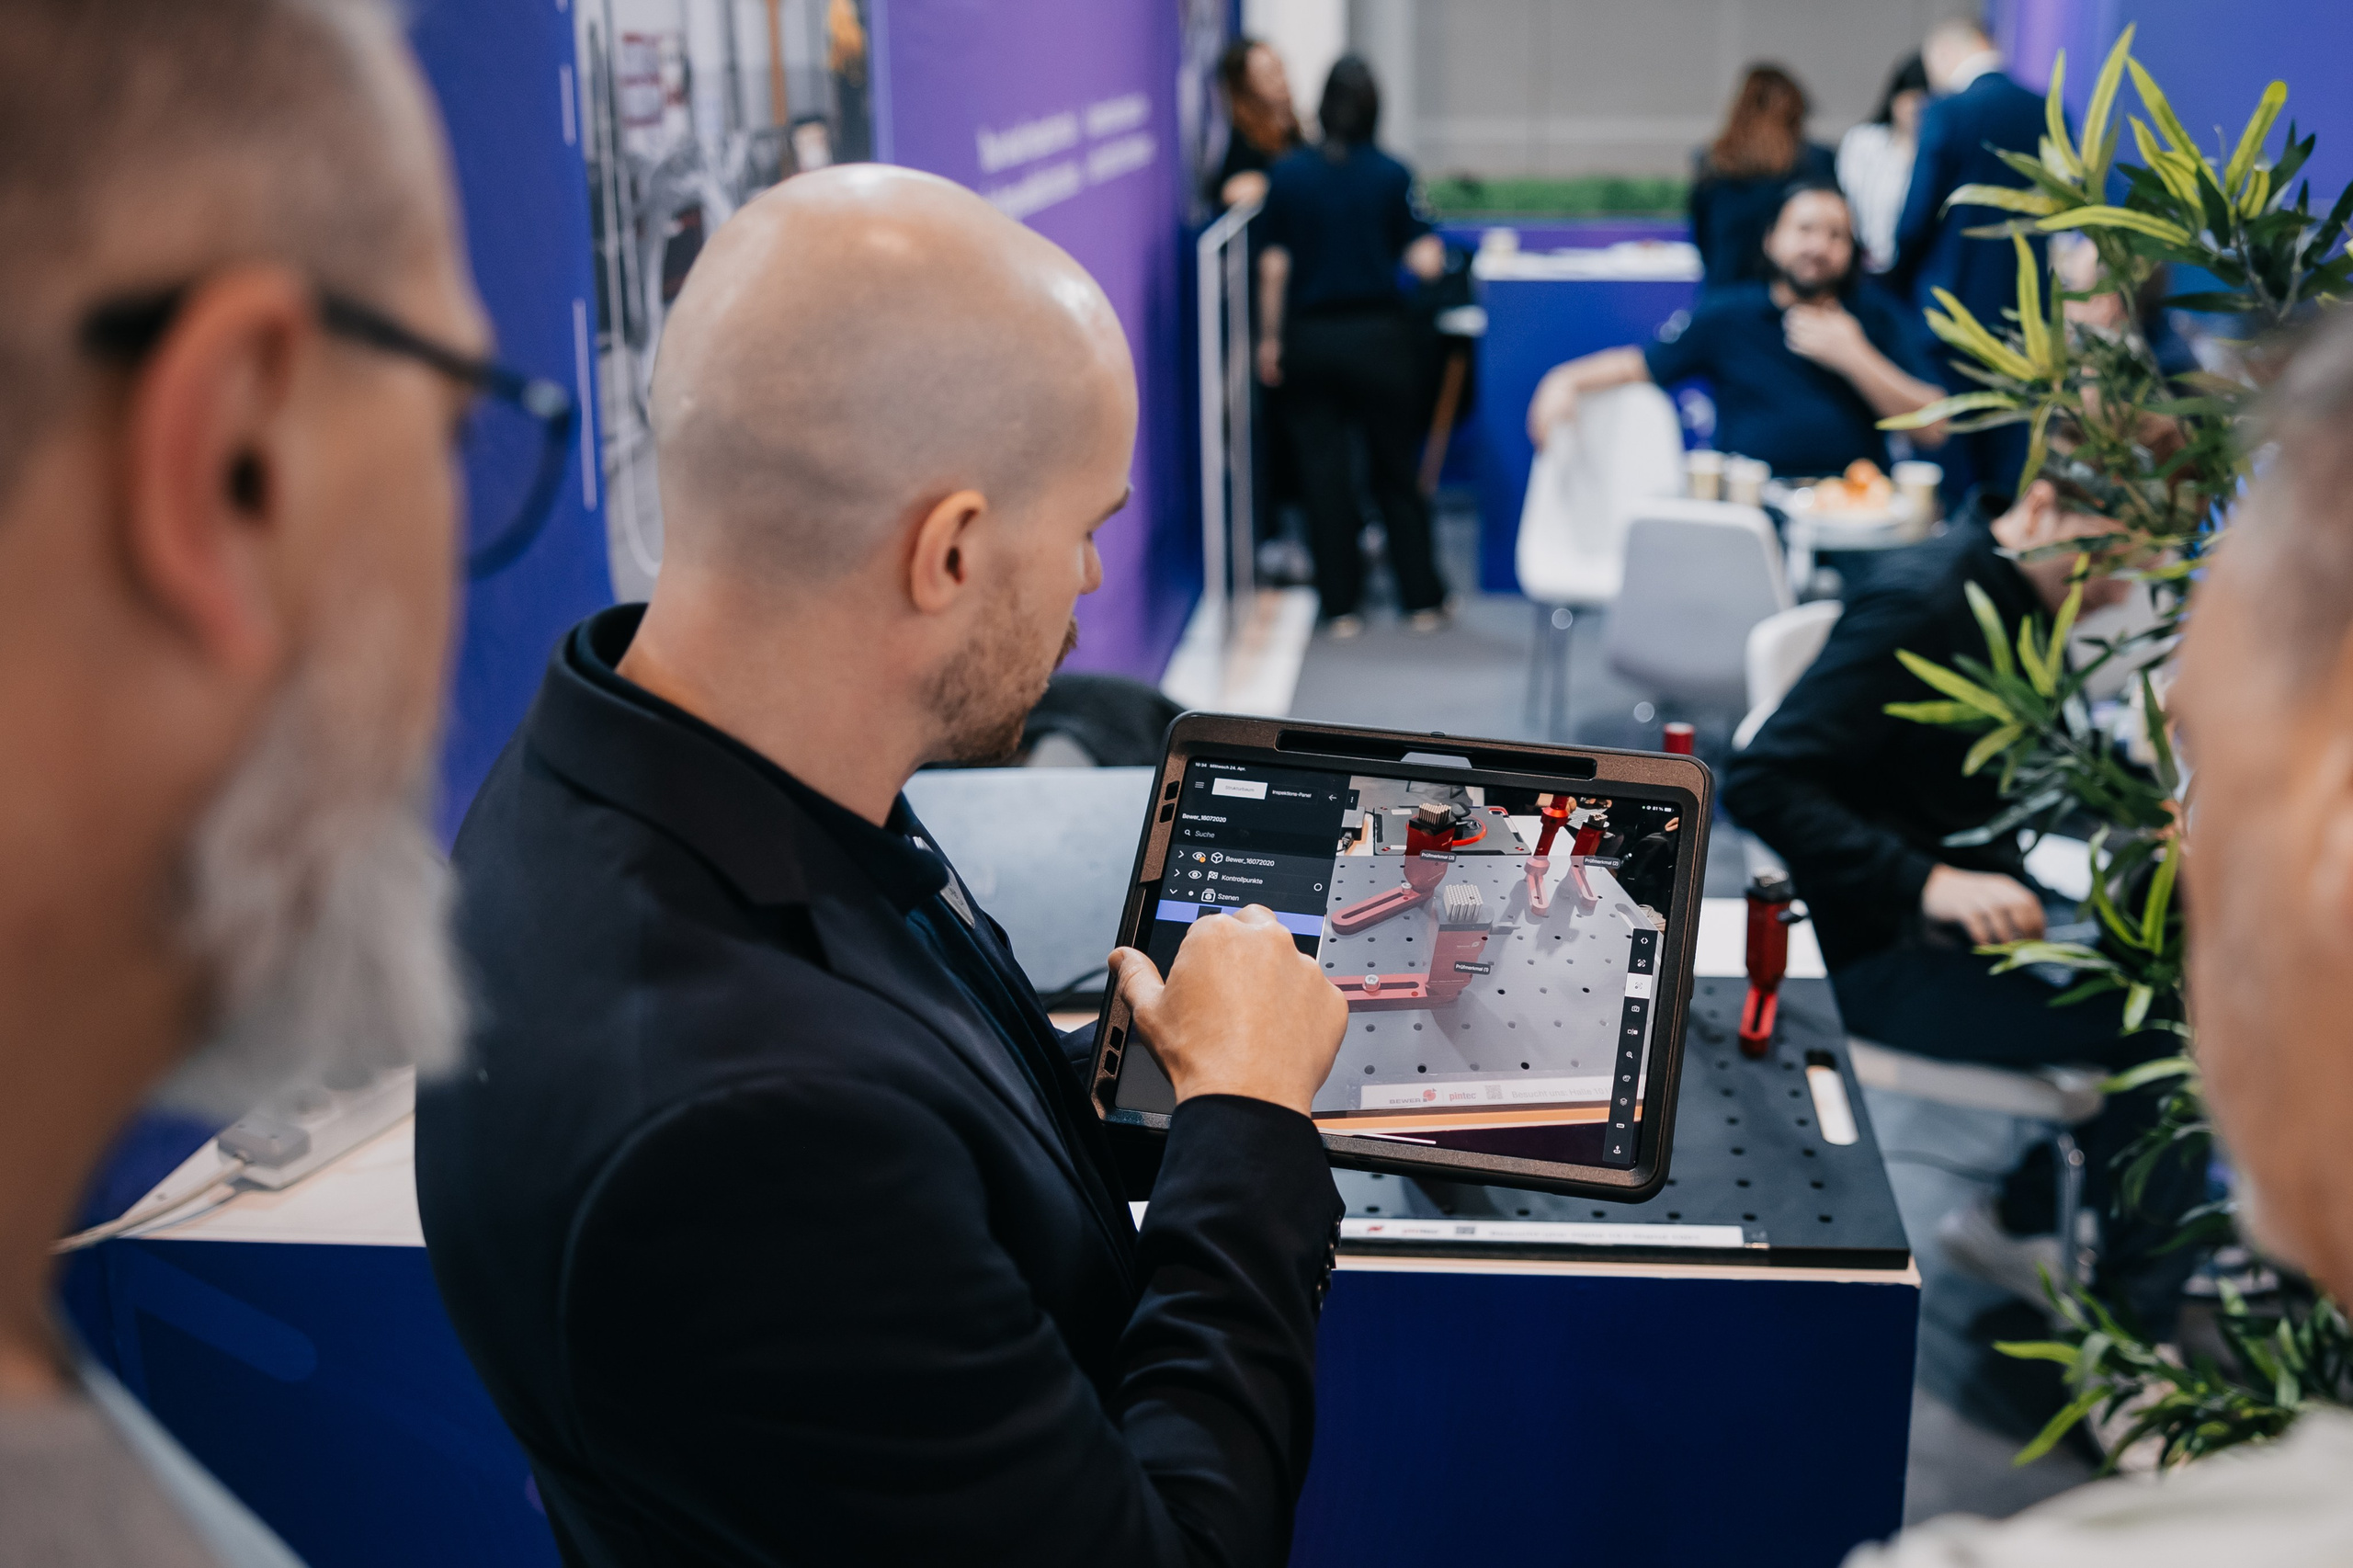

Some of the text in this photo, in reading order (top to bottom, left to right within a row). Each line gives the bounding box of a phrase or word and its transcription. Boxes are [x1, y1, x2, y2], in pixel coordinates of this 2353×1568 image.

[1272, 790, 1312, 798] Inspektions-Panel
[1195, 830, 1215, 838] Suche
[1222, 875, 1263, 884] Kontrollpunkte
[1449, 1092, 1476, 1101] pintec
[1512, 1089, 1547, 1098] Besucht
[1569, 1088, 1592, 1096] Halle
[1594, 1087, 1605, 1096] 10
